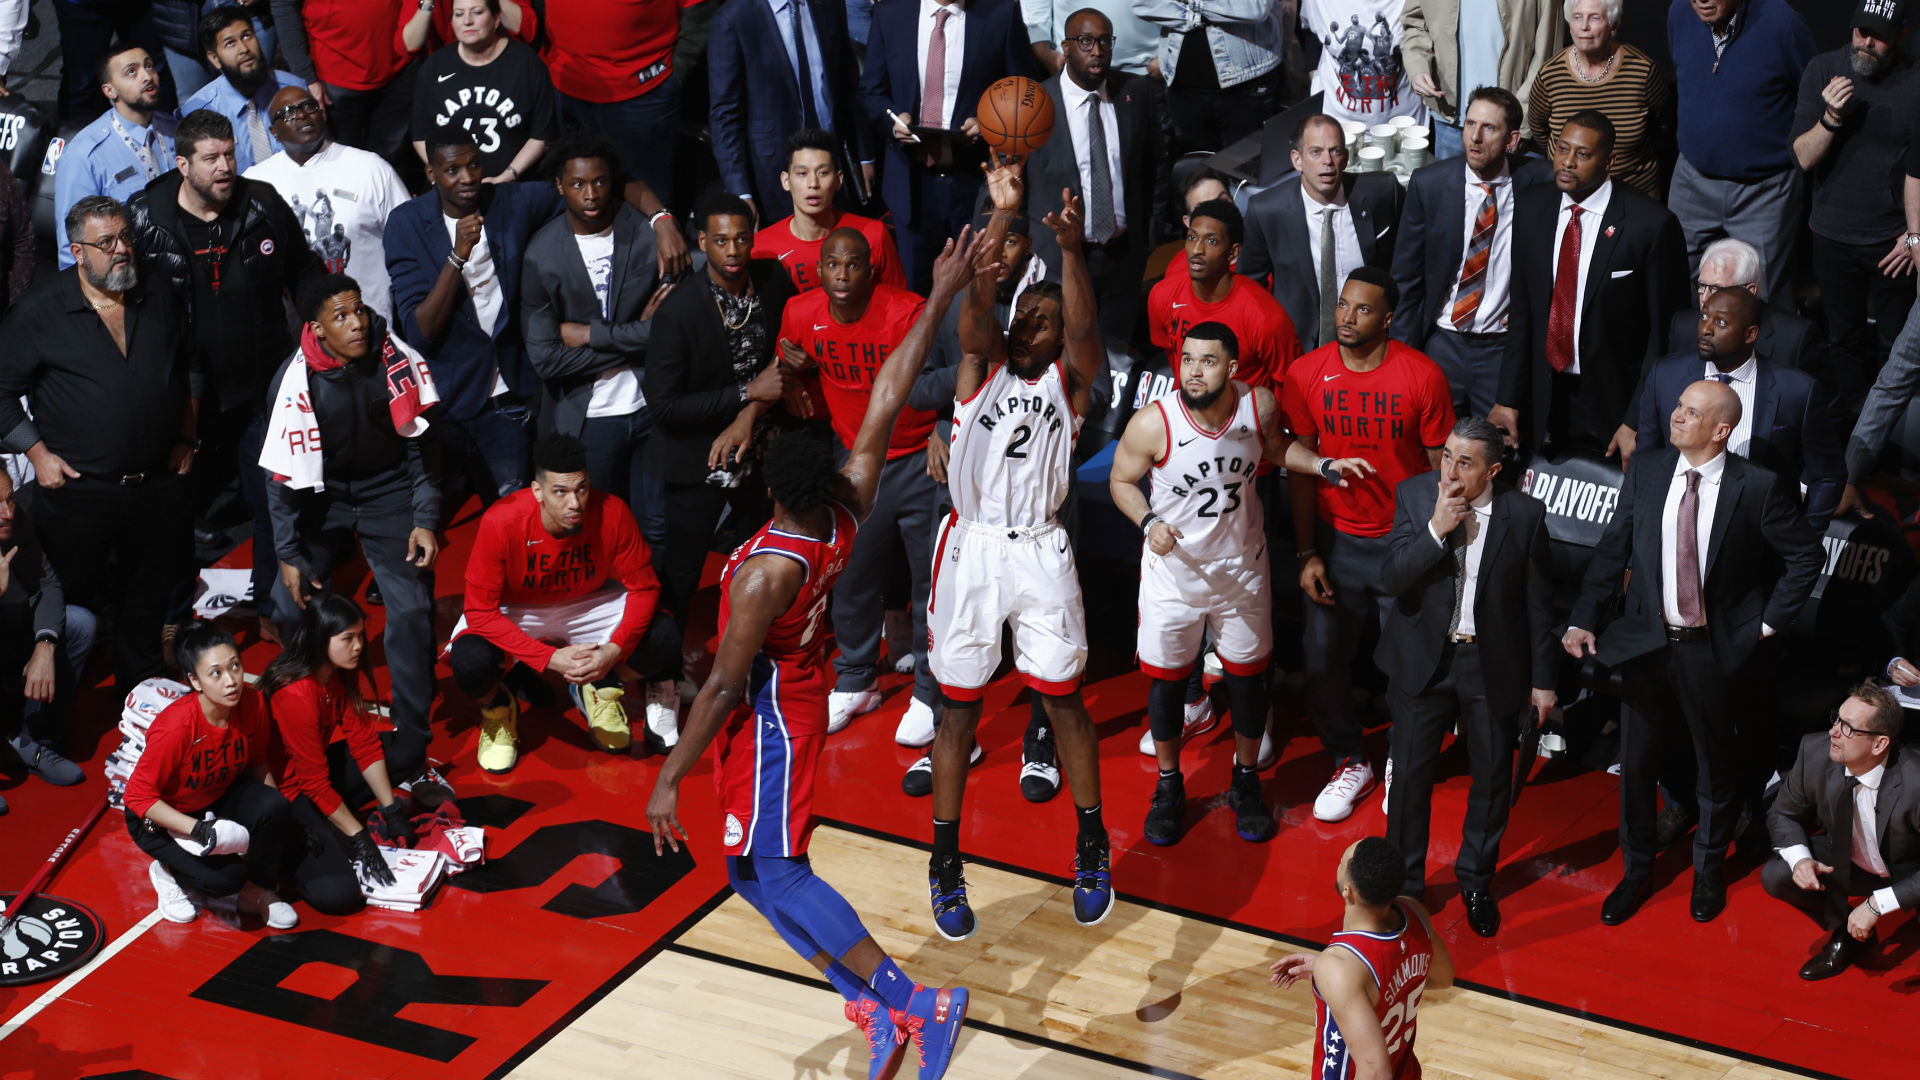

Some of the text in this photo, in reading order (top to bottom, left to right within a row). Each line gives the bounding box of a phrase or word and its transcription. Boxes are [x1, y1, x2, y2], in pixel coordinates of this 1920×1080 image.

[1863, 3, 1894, 20] NORTH
[436, 86, 522, 127] RAPTORS
[814, 337, 889, 364] WE THE
[978, 396, 1061, 432] RAPTORS
[1323, 389, 1402, 416] WE THE
[1006, 424, 1032, 459] 2
[1323, 413, 1404, 440] NORTH
[1197, 481, 1242, 518] 23
[527, 543, 594, 573] WE THE
[522, 564, 597, 589] NORTH
[191, 750, 214, 773] WE
[1, 906, 84, 976] RAPTORS
[1384, 952, 1431, 1006] SIMMONS
[1380, 978, 1427, 1056] 25
